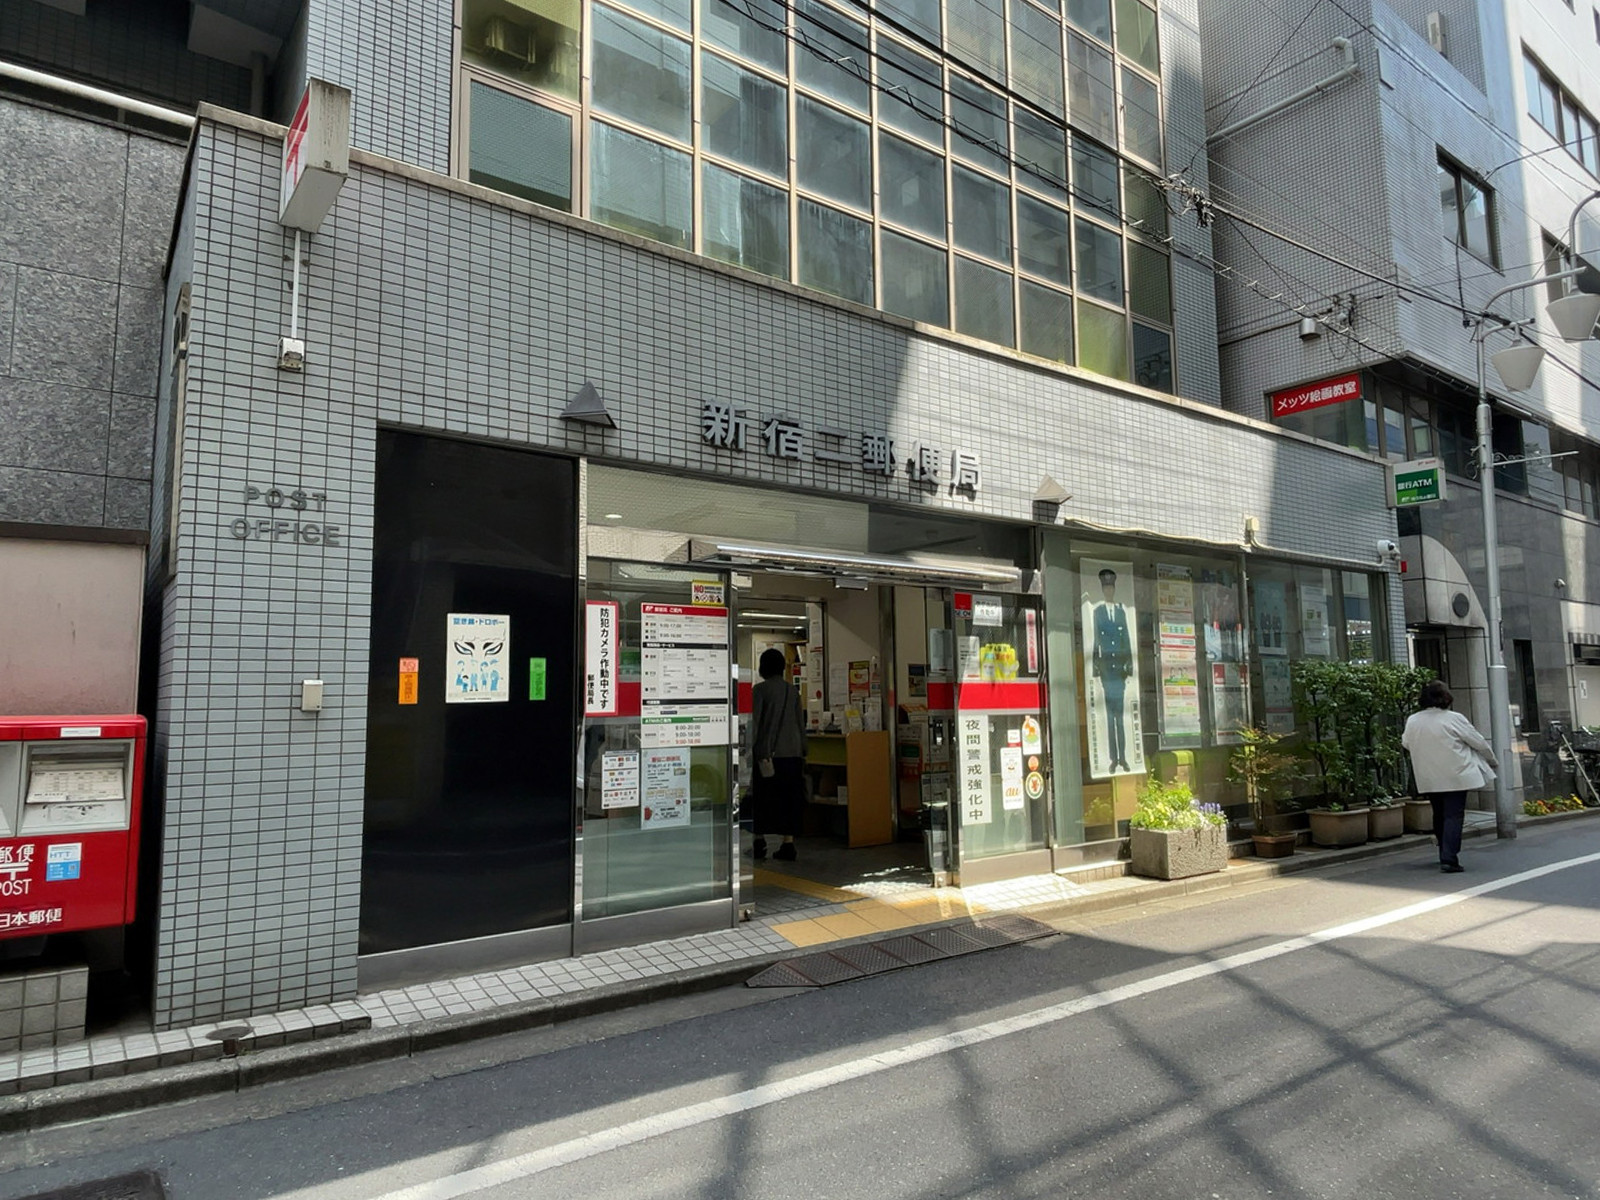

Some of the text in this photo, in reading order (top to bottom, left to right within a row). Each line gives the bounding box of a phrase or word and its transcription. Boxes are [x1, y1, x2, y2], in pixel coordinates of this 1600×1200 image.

[1277, 380, 1357, 411] メッツ絵画教室
[701, 399, 983, 495] 新宿二郵便局
[244, 486, 327, 511] POST
[230, 518, 341, 546] OFFICE
[600, 607, 609, 709] 防犯カメラ作動中です
[965, 719, 983, 821] 夜間警戒強化中
[0, 879, 33, 896] OST
